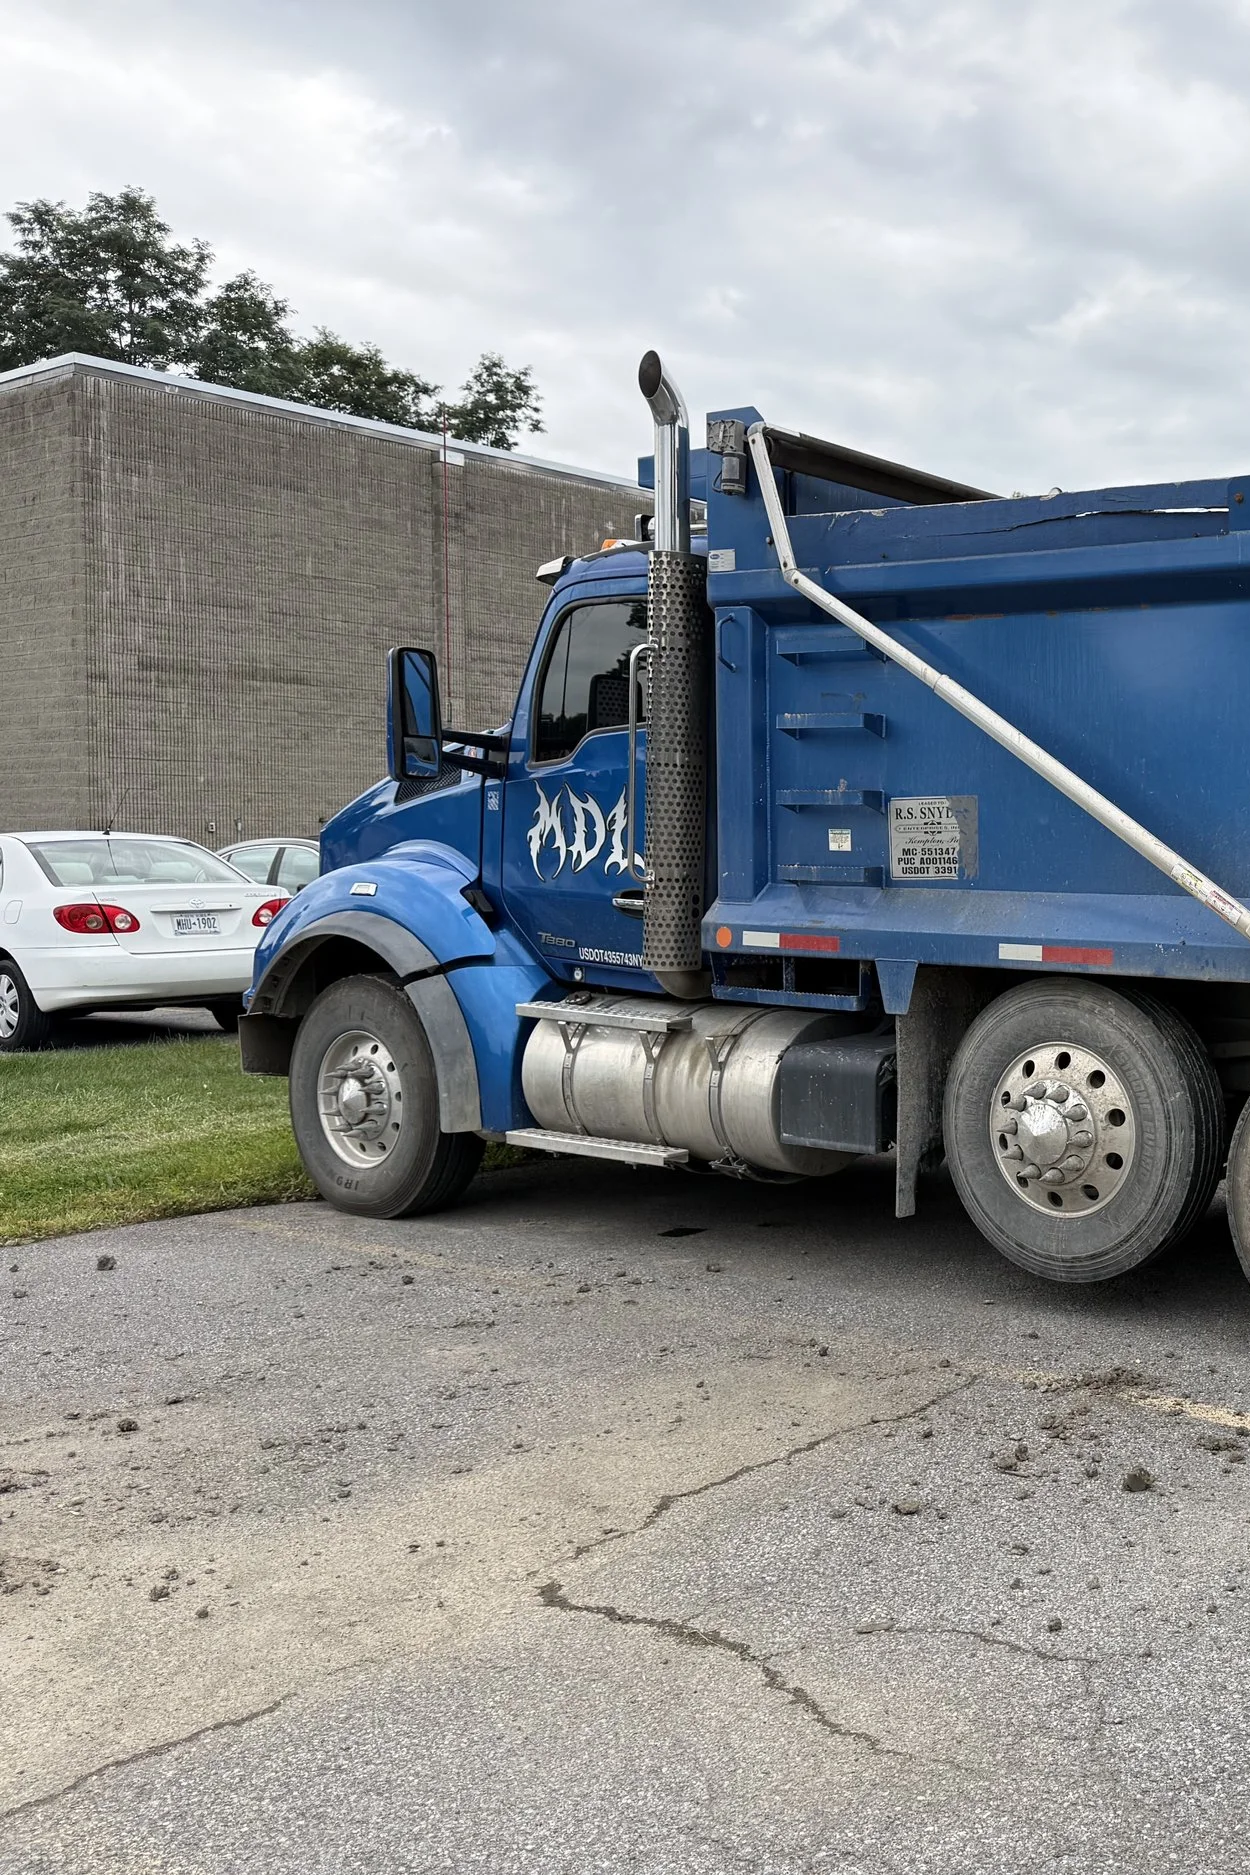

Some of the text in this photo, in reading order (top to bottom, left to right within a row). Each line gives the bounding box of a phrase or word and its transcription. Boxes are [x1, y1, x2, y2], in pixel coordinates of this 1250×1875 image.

[895, 807, 917, 820] R.S.
[902, 847, 956, 856] MC-551347
[897, 857, 916, 865] PUC
[934, 866, 957, 874] 3391
[176, 917, 217, 930] MHU 1902
